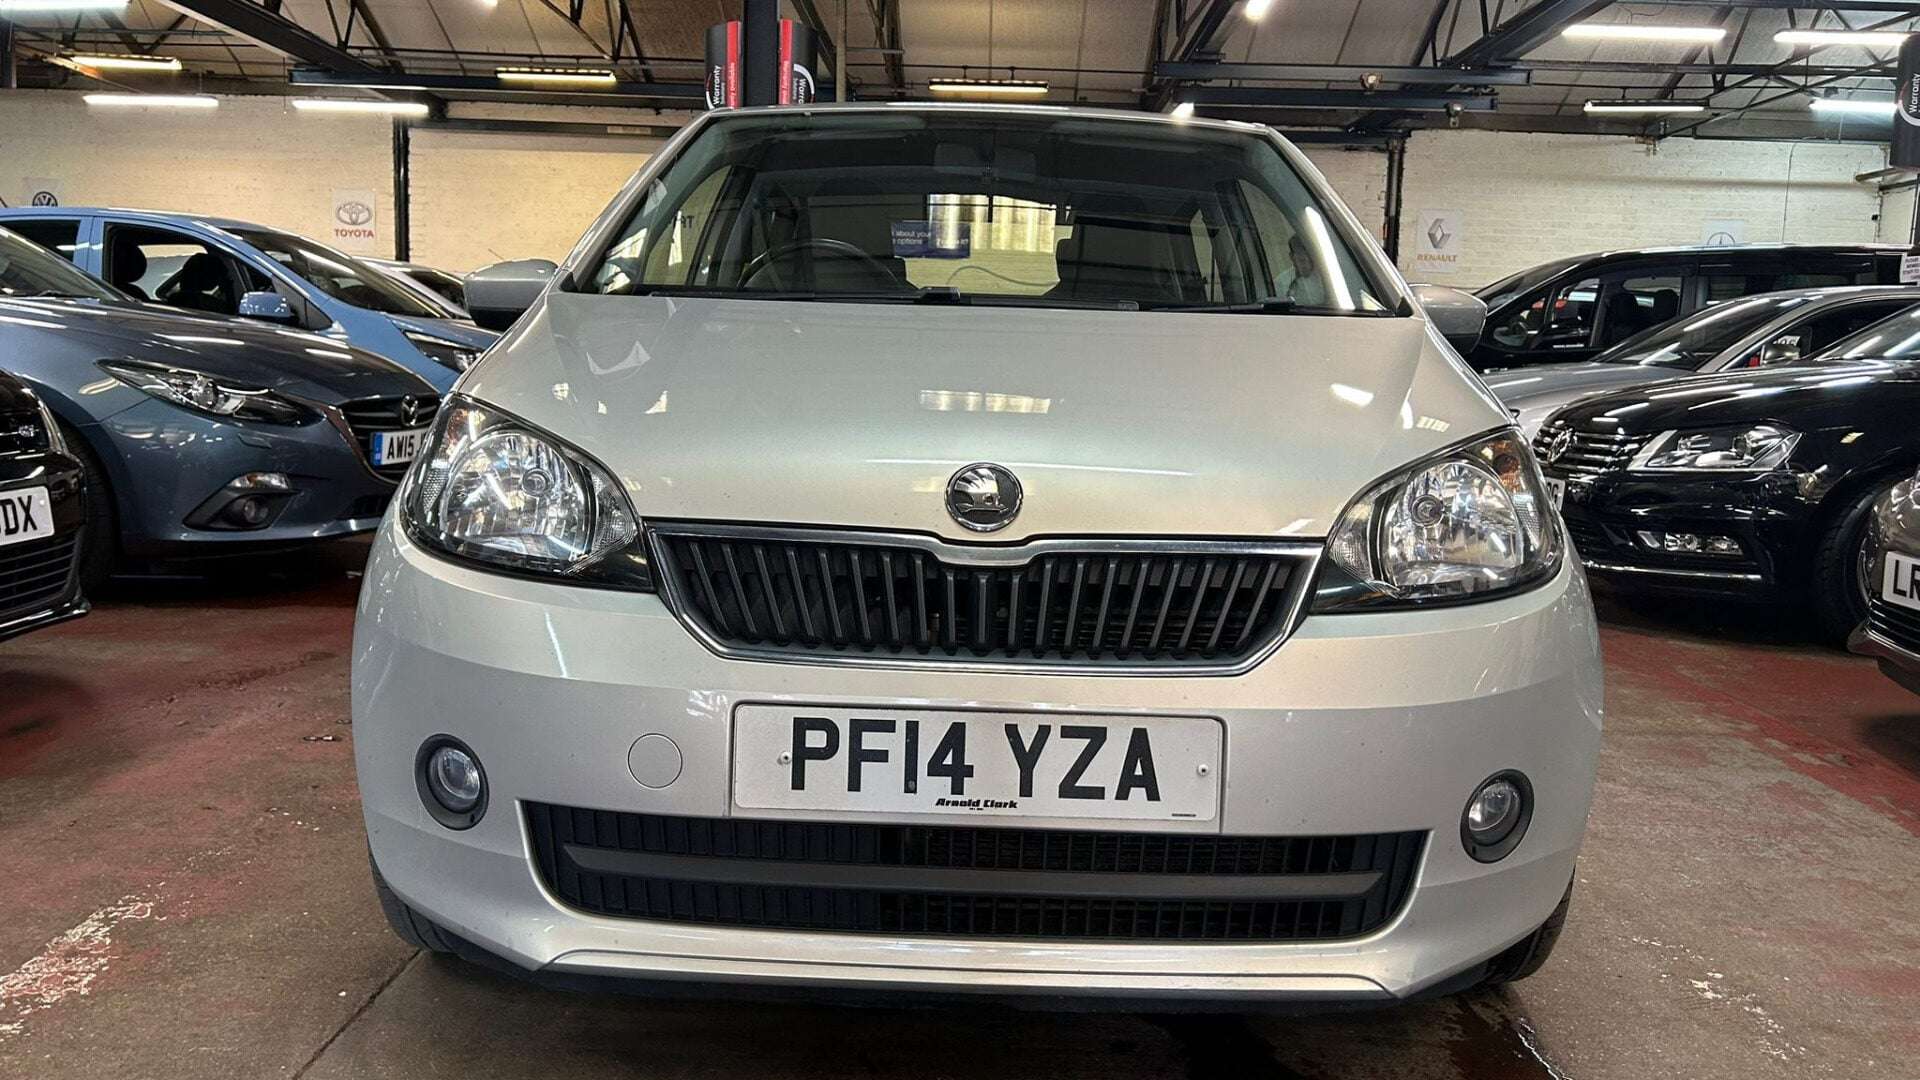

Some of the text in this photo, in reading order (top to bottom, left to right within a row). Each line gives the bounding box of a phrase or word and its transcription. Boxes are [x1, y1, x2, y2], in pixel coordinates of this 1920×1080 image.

[713, 65, 722, 105] Warranty
[1908, 73, 1920, 113] Warranty
[334, 228, 374, 238] TOYOTA
[1416, 253, 1458, 262] RENAULT
[387, 434, 415, 460] AW15
[0, 495, 38, 536] DX
[791, 716, 1162, 802] PF14 YZA
[935, 797, 1018, 809] Arnold Clark
